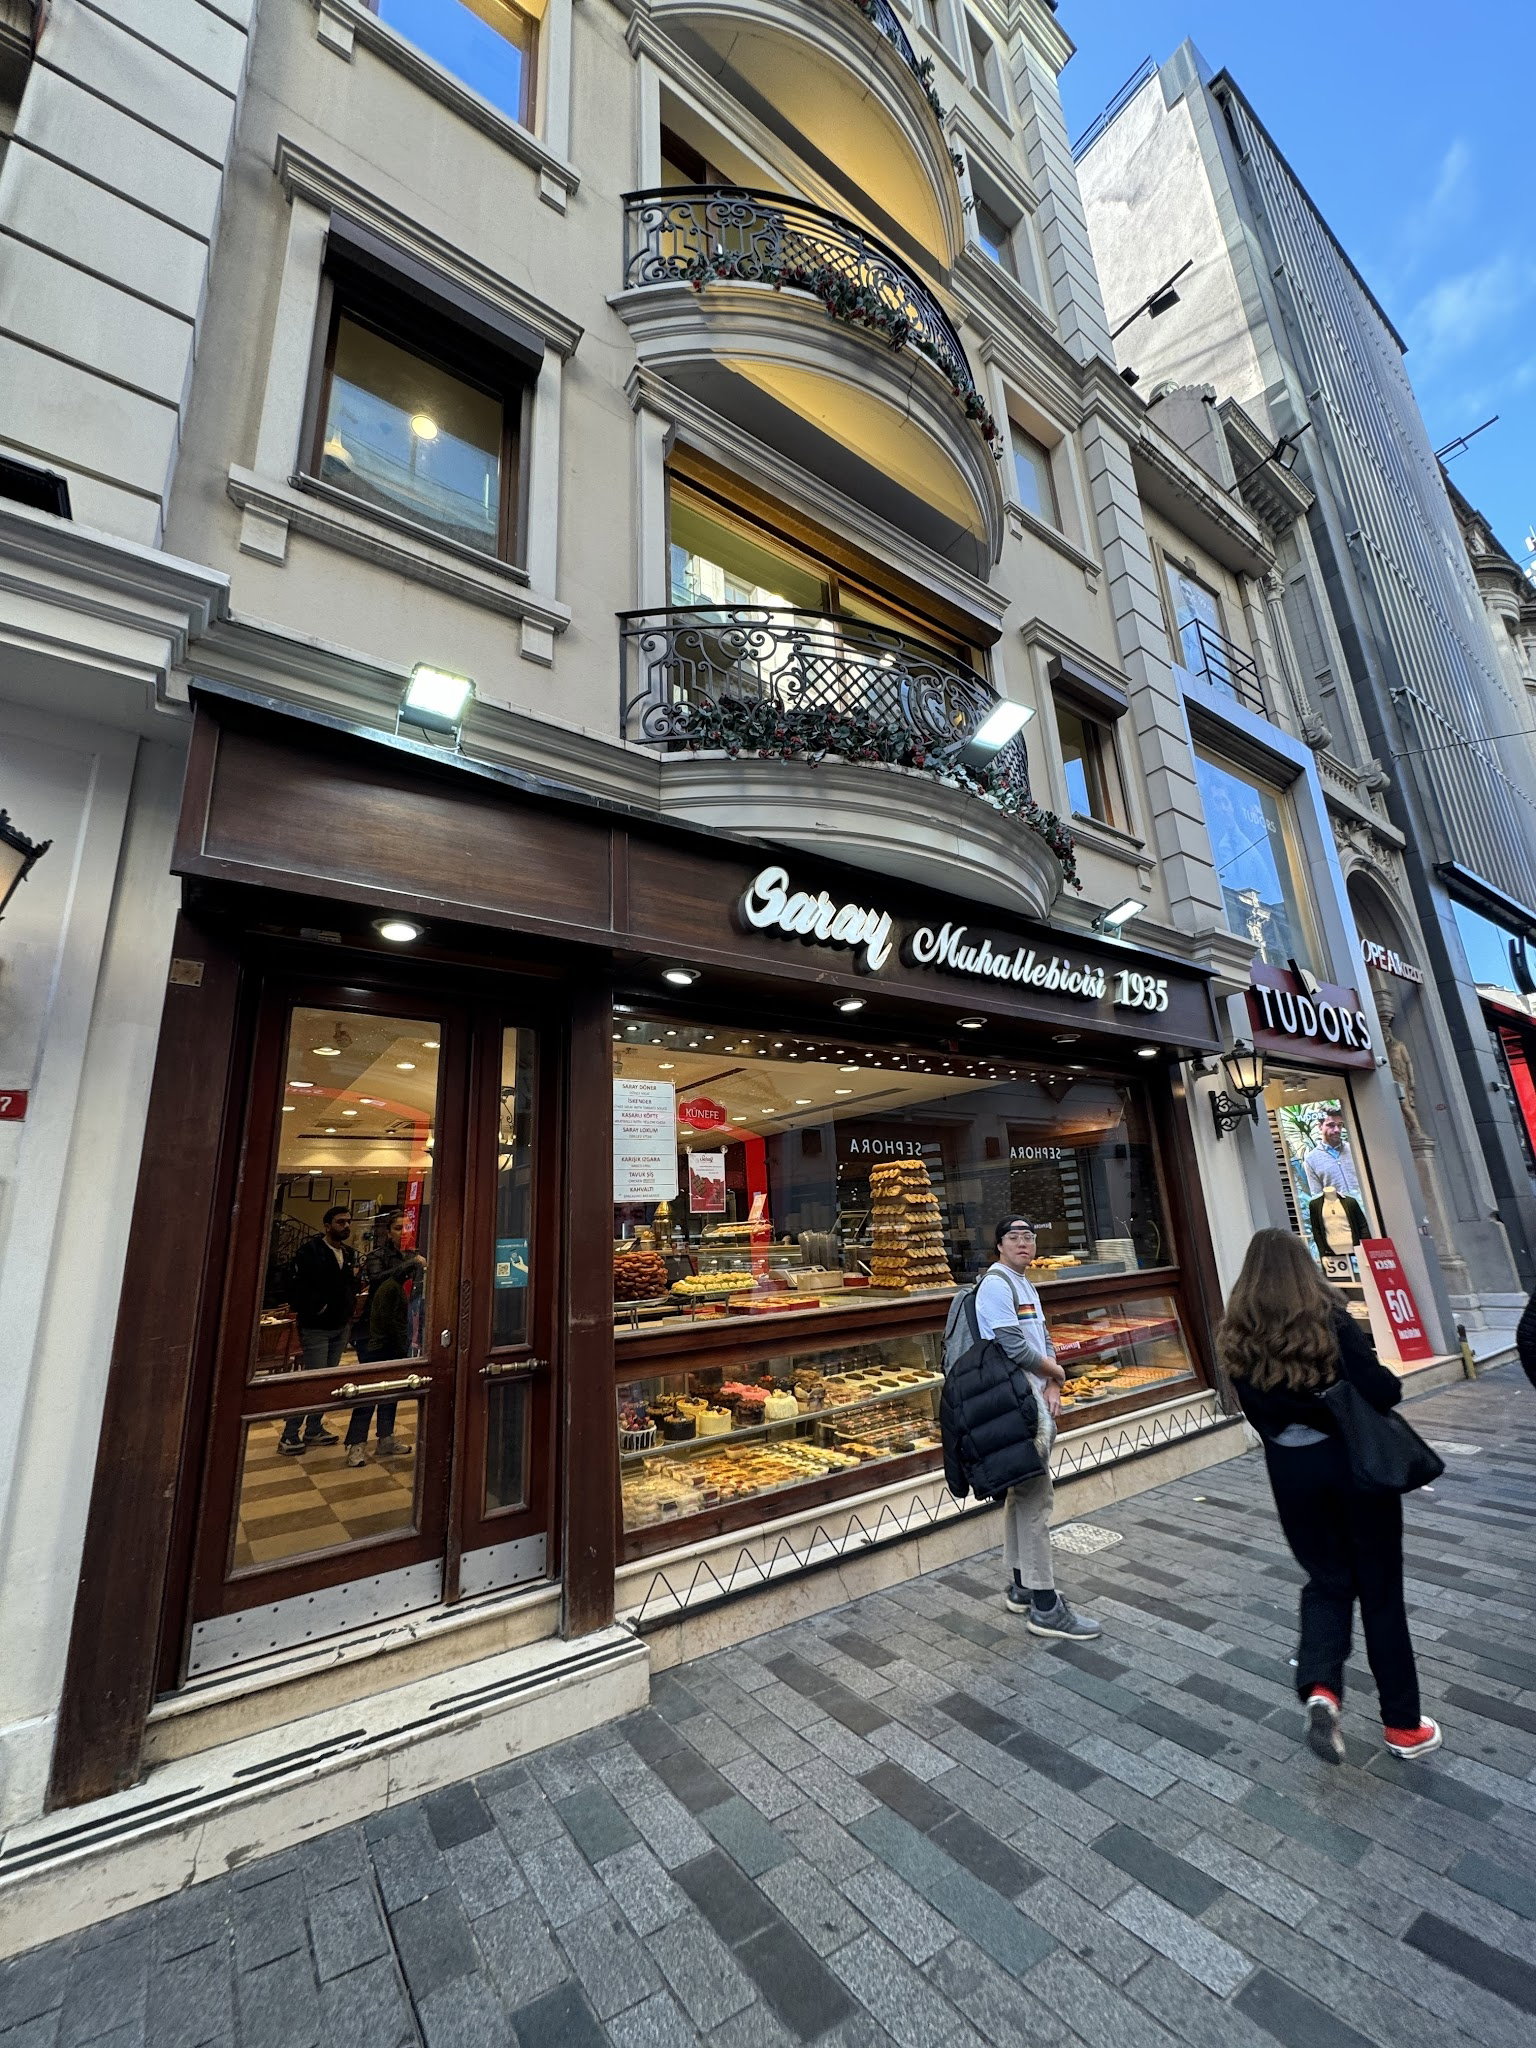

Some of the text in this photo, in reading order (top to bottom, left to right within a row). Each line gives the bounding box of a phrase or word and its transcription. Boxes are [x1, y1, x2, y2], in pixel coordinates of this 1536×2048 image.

[745, 866, 1169, 1012] Saray Muhallebicisi 1935
[1256, 983, 1372, 1050] TUDORS
[685, 1107, 720, 1120] KÜNEFE
[1296, 1111, 1328, 1121] TUDORS
[1384, 1288, 1415, 1324] 50
